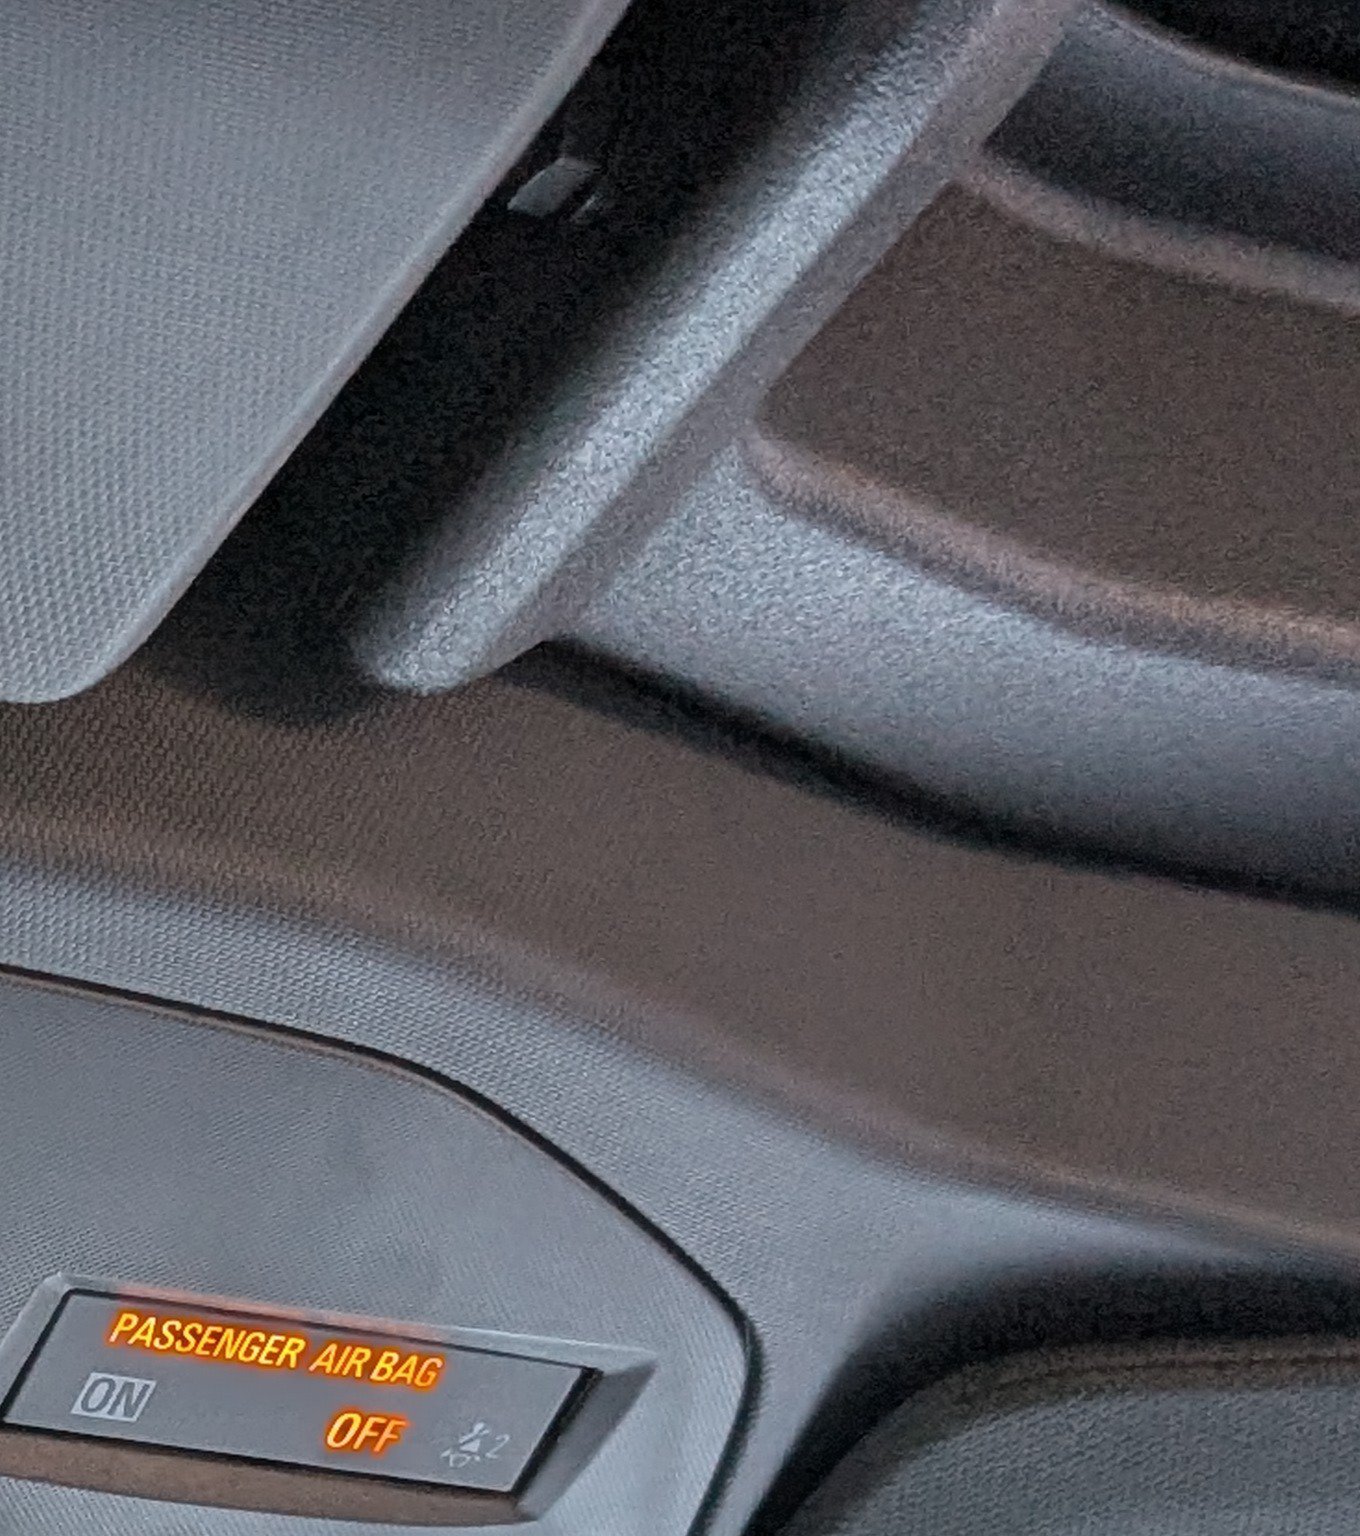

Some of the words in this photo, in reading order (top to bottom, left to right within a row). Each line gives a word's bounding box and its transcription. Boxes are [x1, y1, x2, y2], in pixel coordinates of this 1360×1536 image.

[108, 1312, 307, 1369] PASSENGER
[307, 1342, 372, 1379] AIR
[368, 1350, 444, 1388] BAG
[79, 1376, 151, 1419] ON
[325, 1412, 409, 1453] OFF
